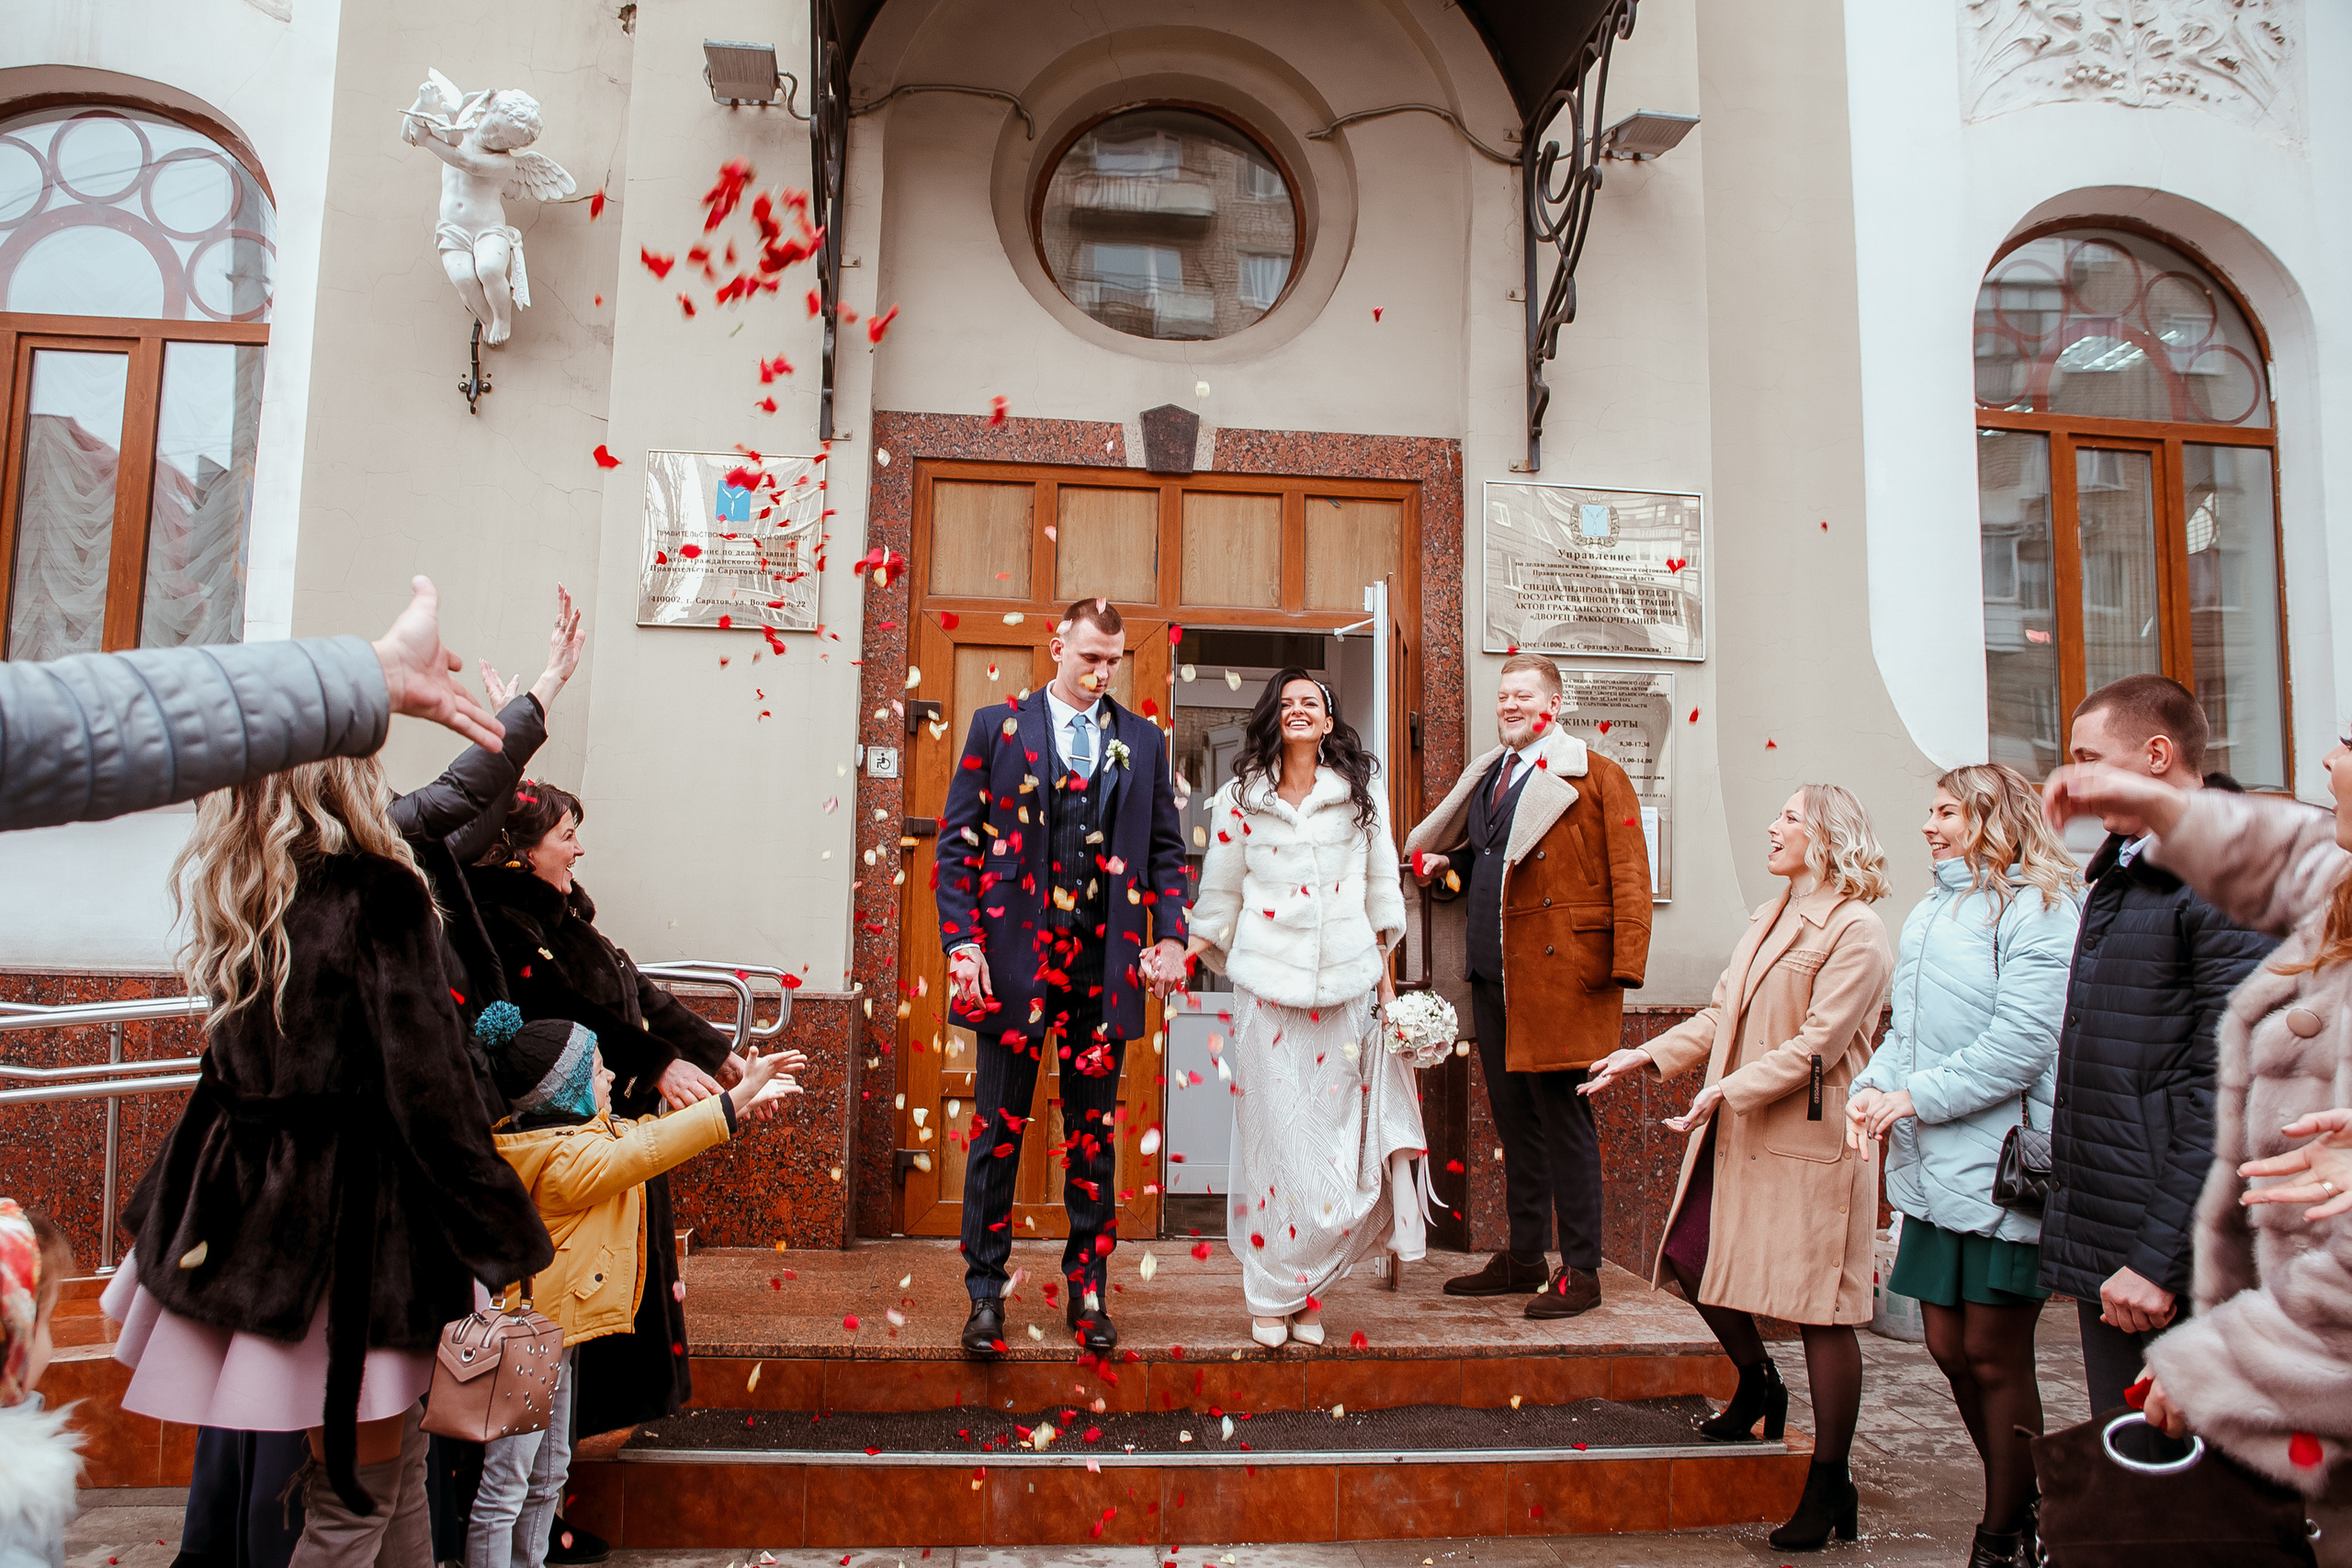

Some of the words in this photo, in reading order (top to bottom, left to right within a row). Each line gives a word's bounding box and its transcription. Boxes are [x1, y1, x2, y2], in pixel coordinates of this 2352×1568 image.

[657, 530, 718, 538] ПРАВИТЕЛЬСТВО
[1558, 548, 1632, 561] Управление
[690, 558, 751, 566] гражданского
[753, 558, 797, 567] сотояния
[650, 565, 715, 573] Правительства
[718, 567, 773, 576] Саратовской
[1532, 570, 1584, 578] Правительства
[1585, 571, 1628, 581] Саратовской
[1629, 573, 1655, 581] области
[1522, 583, 1635, 595] СПЕЦИАЛИЗИРОВАННЫЙ
[1637, 589, 1668, 597] ОТДЕЛ
[695, 597, 731, 605] Саратов,
[1517, 592, 1608, 604] ГОСУДАРСТВЕННОЙ
[1611, 597, 1674, 607] РЕГИСТРАЦИИ
[1546, 604, 1620, 614] ГРАЖДАНСКОГО
[1623, 607, 1678, 616] СОСТОЯНИЯ
[1530, 613, 1571, 622] «ДВОРЕЦ
[1572, 615, 1660, 625] БРАКОСОЧЕТАНИЙ»
[1516, 640, 1540, 649] Адрес:
[1542, 641, 1568, 649] 410002,
[1577, 643, 1610, 651] Саратов,
[1623, 645, 1662, 654] Волжская,
[1555, 717, 1590, 727] ЕЖИМ
